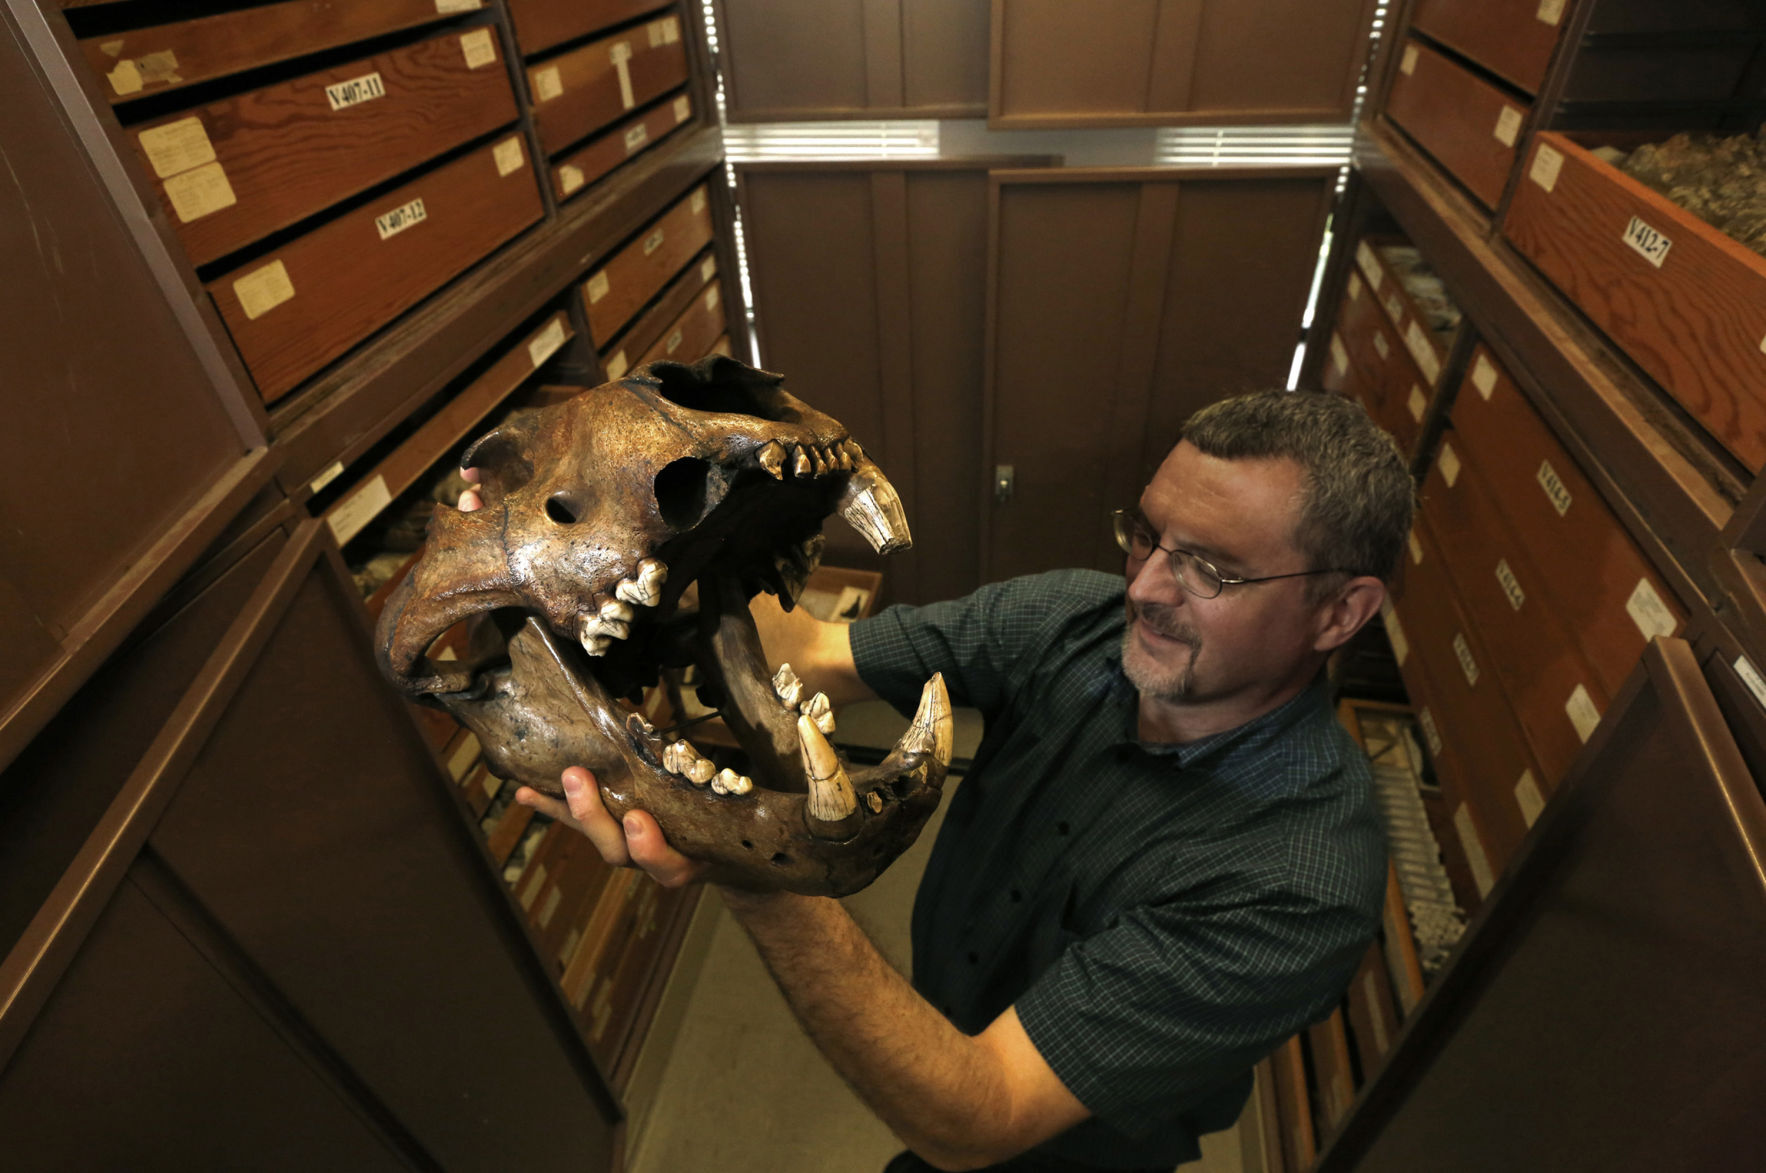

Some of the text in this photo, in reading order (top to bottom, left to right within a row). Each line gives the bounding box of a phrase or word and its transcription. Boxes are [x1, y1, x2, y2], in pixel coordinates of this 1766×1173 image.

[328, 76, 382, 106] V407-11
[378, 201, 424, 234] V407-12
[1629, 217, 1670, 260] V412-7
